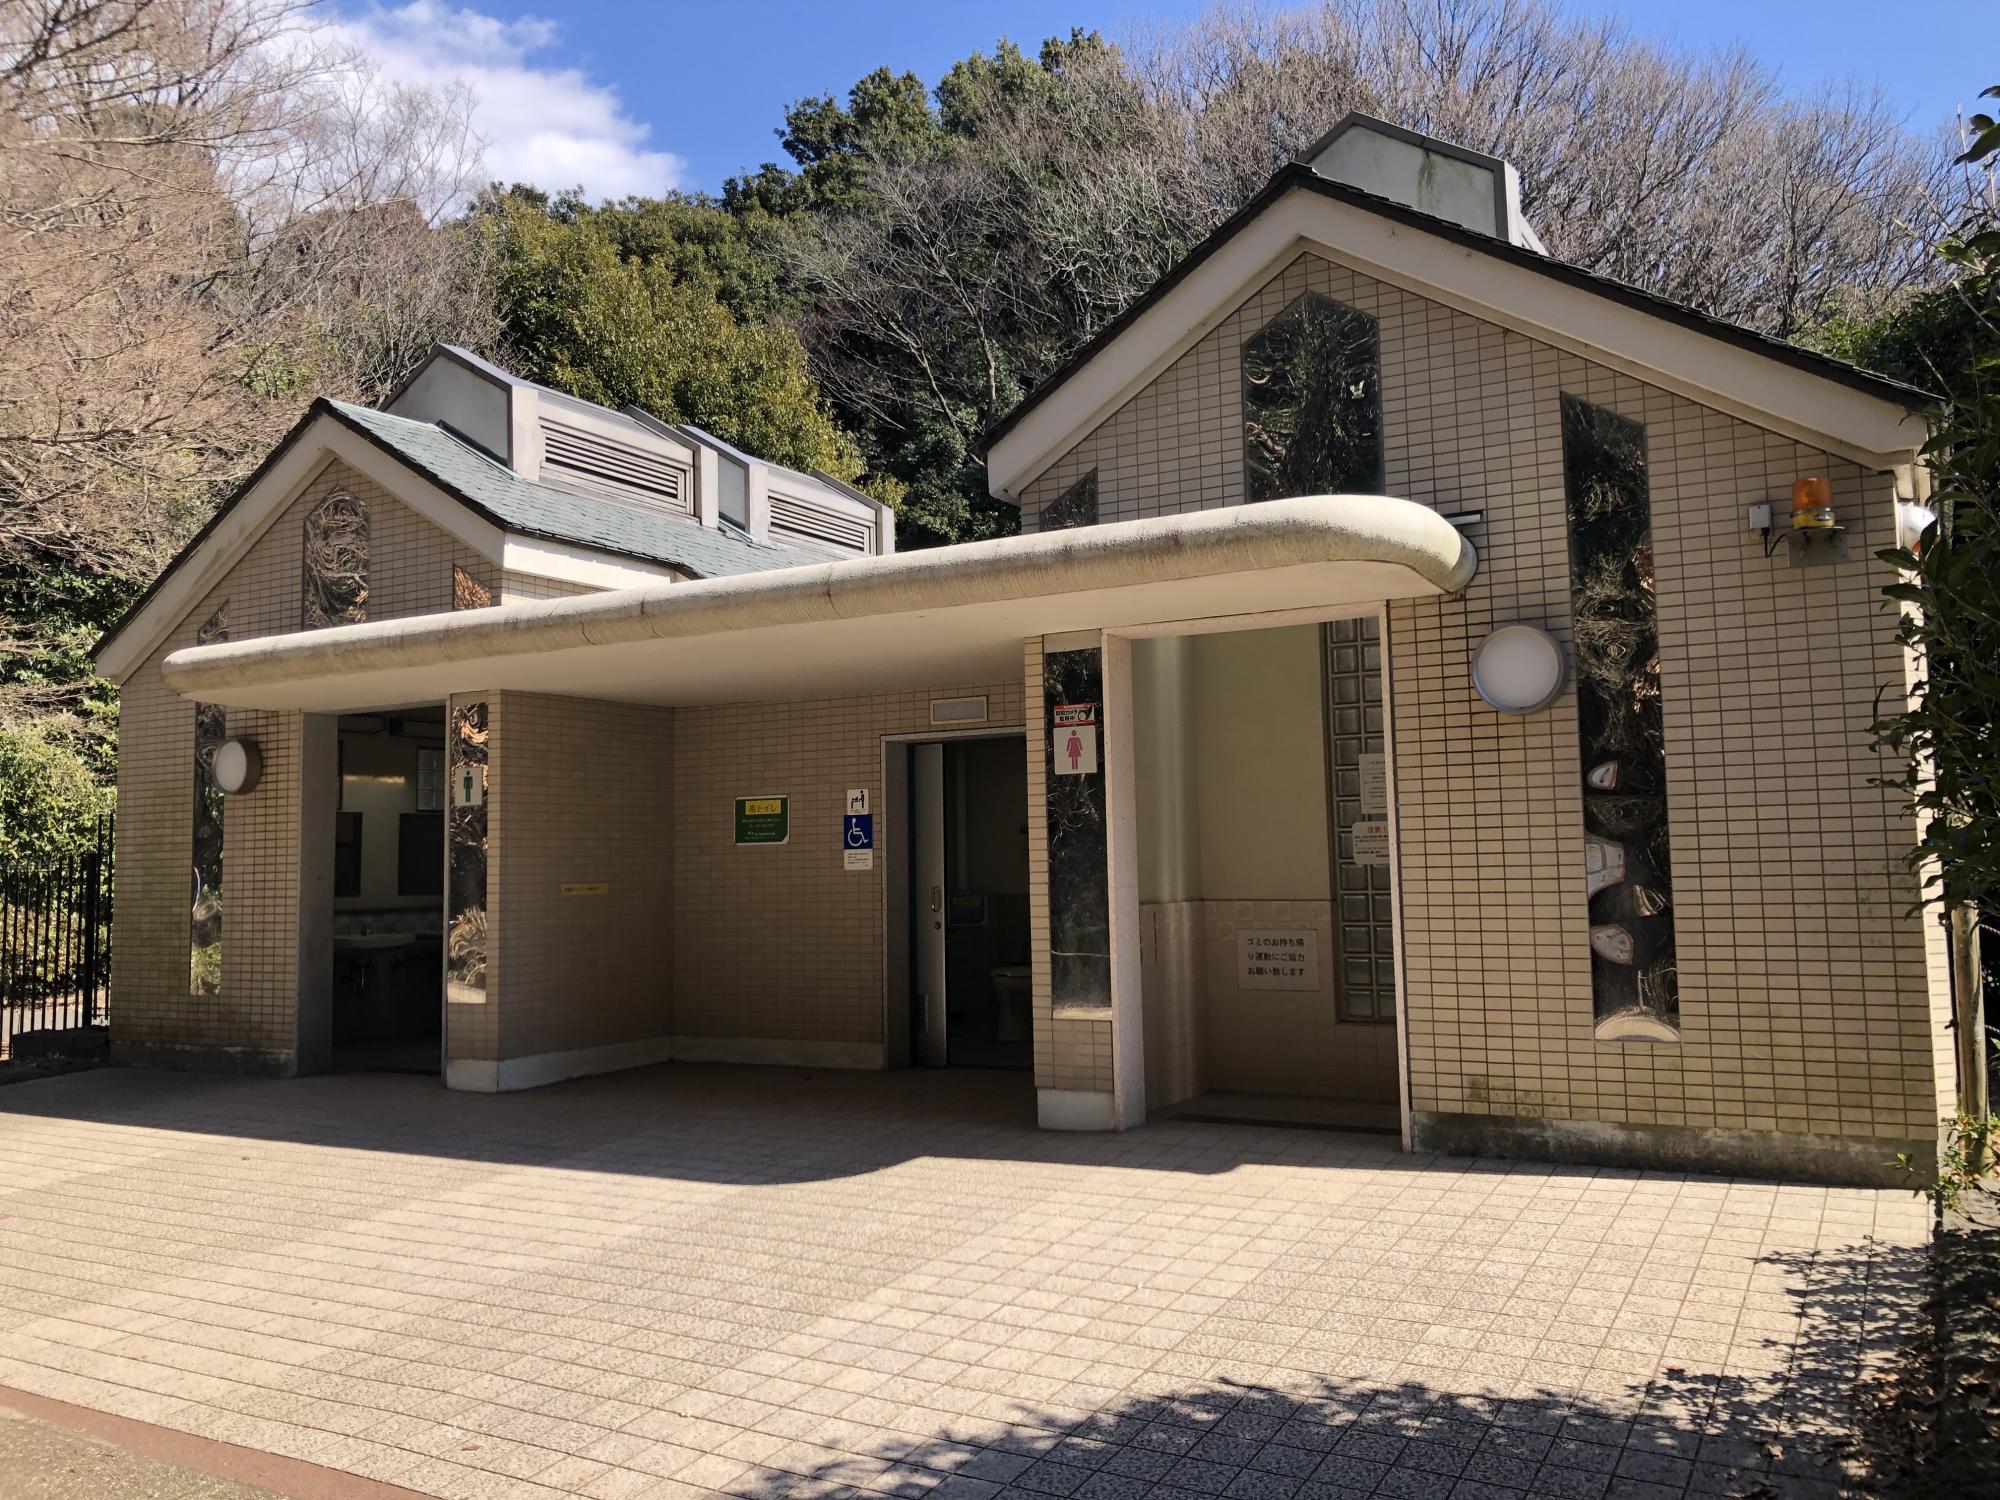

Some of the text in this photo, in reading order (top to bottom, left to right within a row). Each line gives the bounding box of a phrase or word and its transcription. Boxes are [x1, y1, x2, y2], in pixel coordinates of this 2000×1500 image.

[1247, 937, 1305, 948] ゴミのお持ち帰
[1247, 951, 1305, 962] り運動にご協力
[1247, 966, 1306, 977] お願い致します
